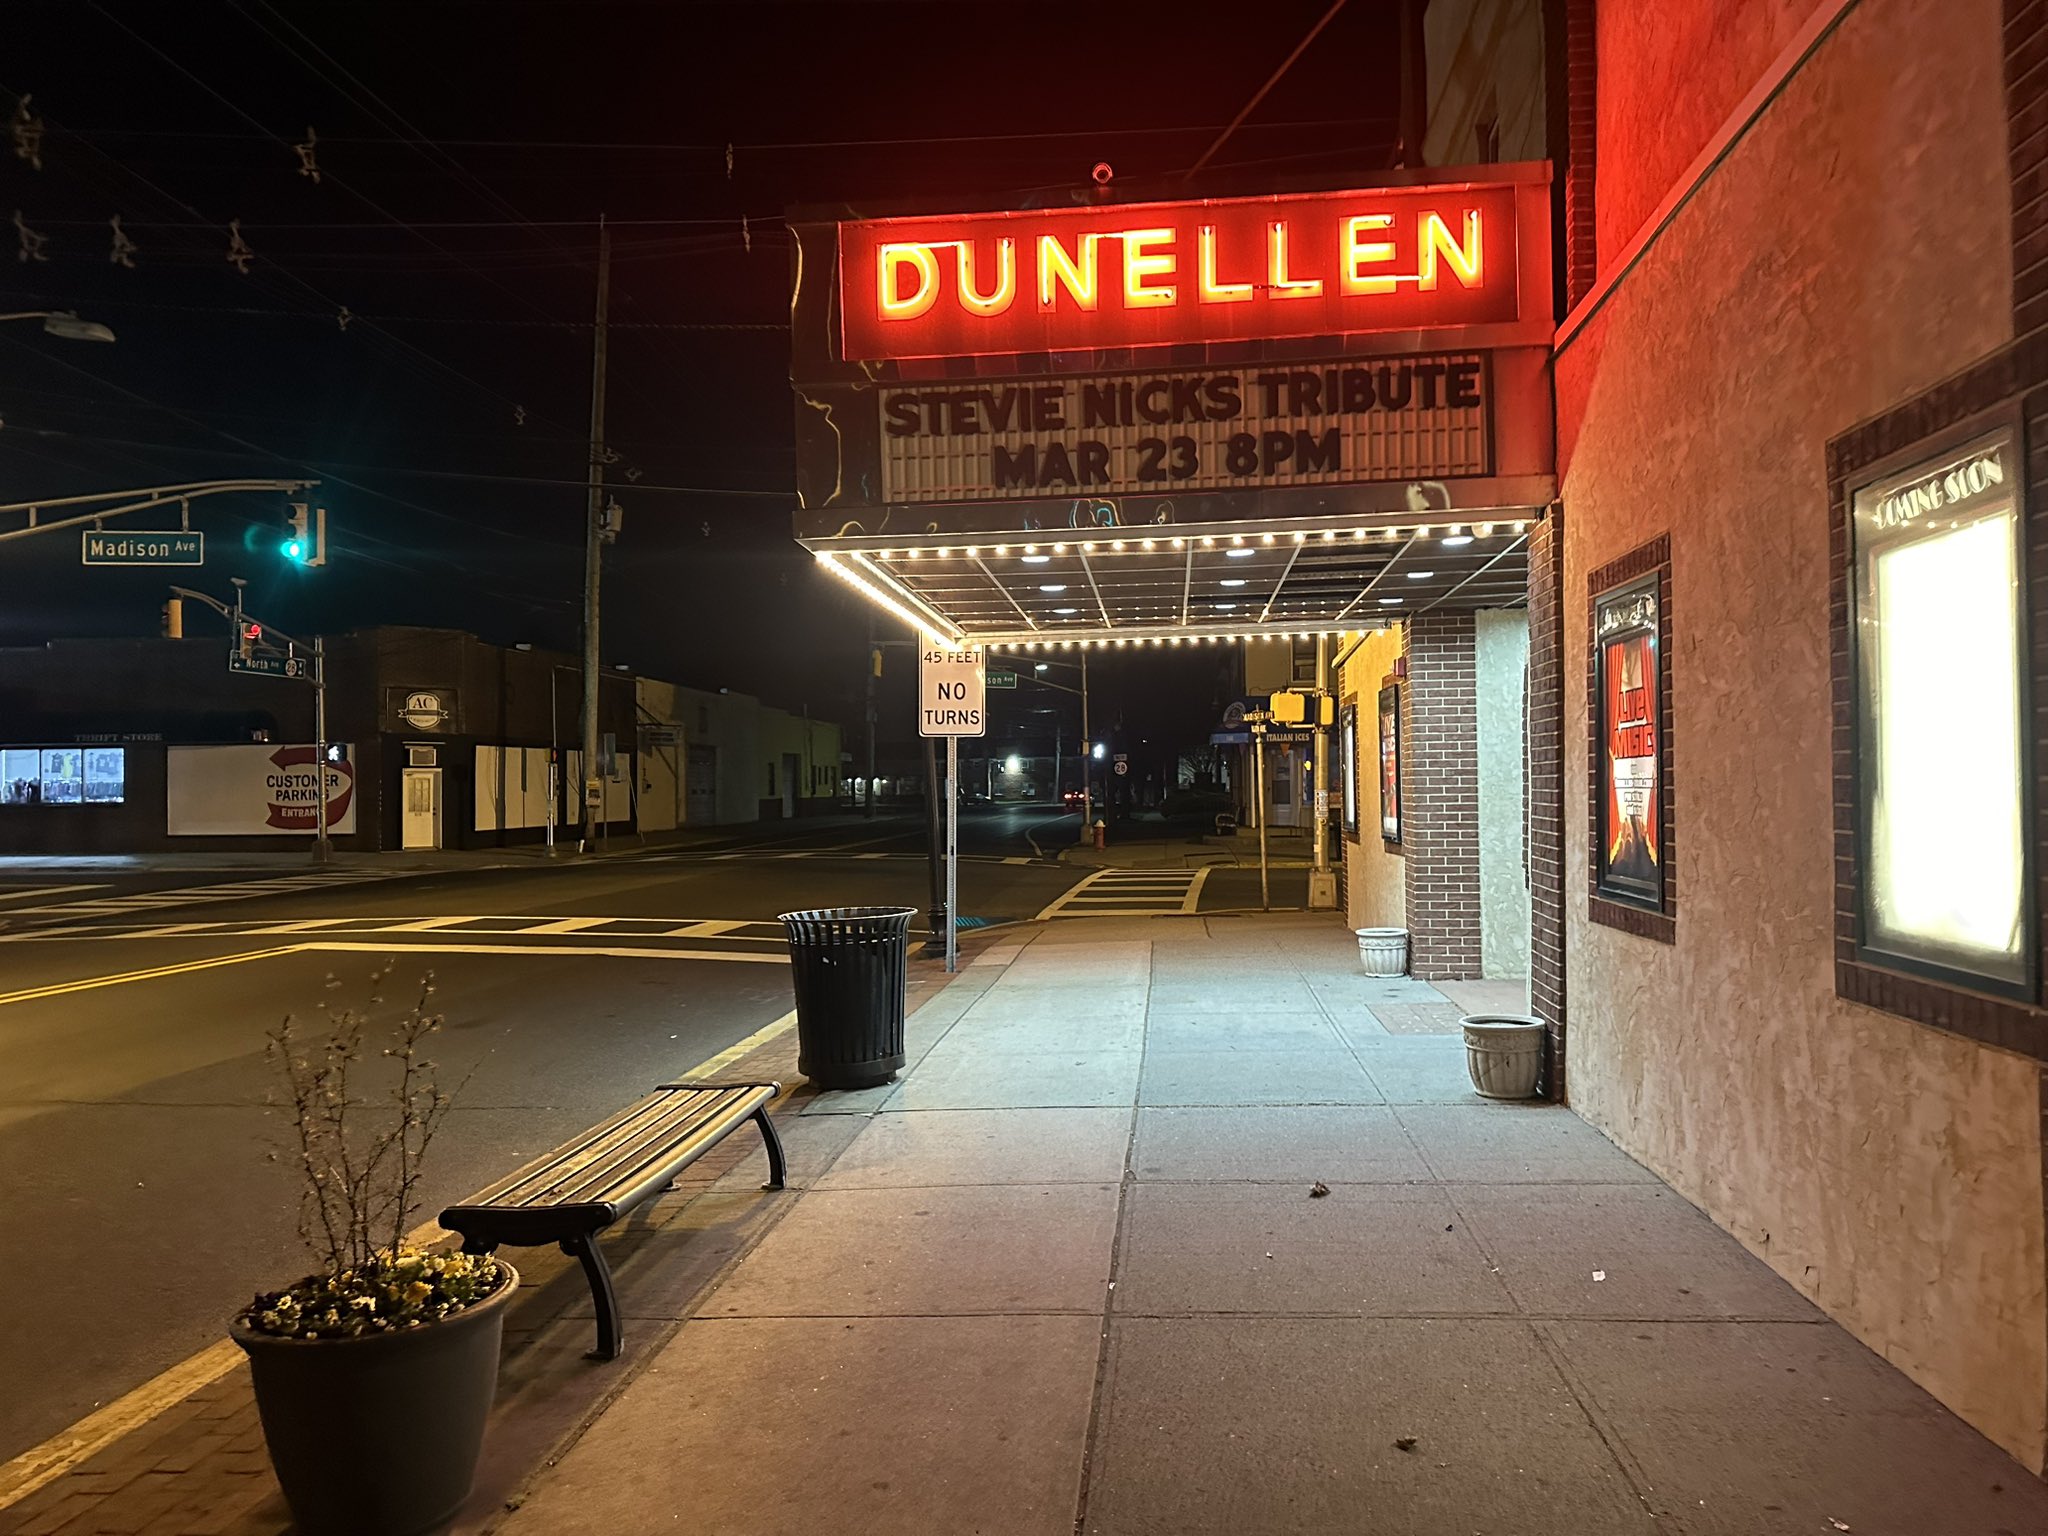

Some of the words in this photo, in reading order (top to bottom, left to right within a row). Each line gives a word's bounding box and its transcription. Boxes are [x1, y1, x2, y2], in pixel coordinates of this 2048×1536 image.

[876, 207, 1483, 322] DUNELLEN
[884, 385, 1066, 438] STEVIE
[1083, 375, 1242, 428] NICKS
[1258, 362, 1481, 419] TRIBUTE
[993, 439, 1112, 490] MAR
[1137, 434, 1199, 483] 23
[1226, 427, 1341, 478] 8PM
[1872, 479, 1944, 529] COMING
[1943, 453, 2003, 504] SOON
[90, 539, 170, 557] Madison
[175, 540, 196, 552] Ave
[245, 657, 269, 670] North
[923, 651, 943, 664] 45
[947, 651, 981, 664] FEET
[937, 682, 966, 701] NO
[412, 697, 433, 709] AC
[1618, 685, 1646, 723] LIVE
[924, 709, 980, 725] TURNS
[75, 733, 118, 742] THRIFT
[122, 733, 162, 741] STORE
[1266, 732, 1294, 741] ITALIAN
[1295, 732, 1310, 741] ICES
[1612, 723, 1654, 760] MUSIC
[1116, 763, 1126, 772] 28
[281, 807, 320, 817] ENTRAN
